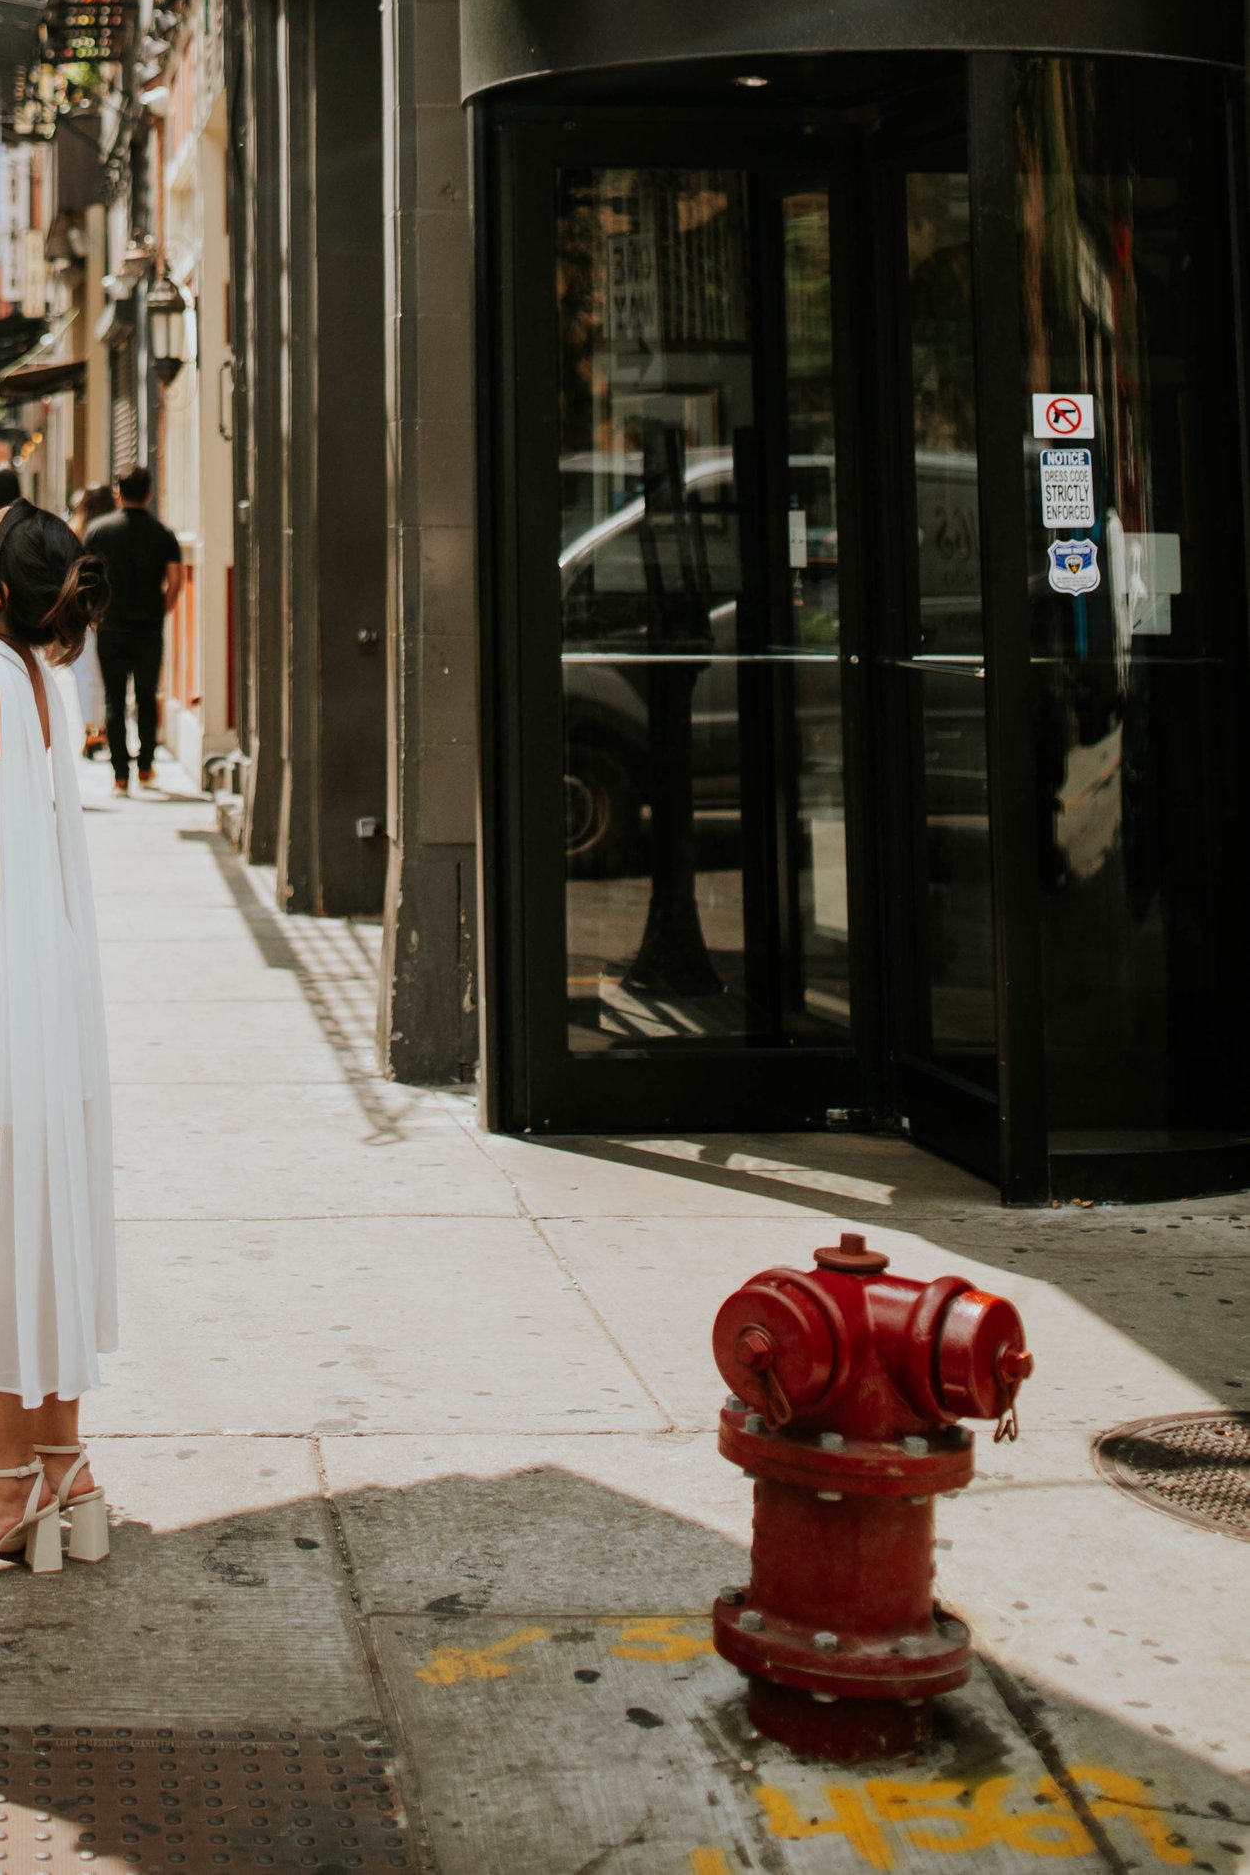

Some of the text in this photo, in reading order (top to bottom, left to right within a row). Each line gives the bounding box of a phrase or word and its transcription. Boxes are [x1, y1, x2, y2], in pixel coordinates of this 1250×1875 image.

[1047, 451, 1085, 465] NOTICE
[1045, 470, 1089, 483] DRESS CODE
[1046, 484, 1090, 502] STRICTLY
[1047, 505, 1090, 520] ENFORCED
